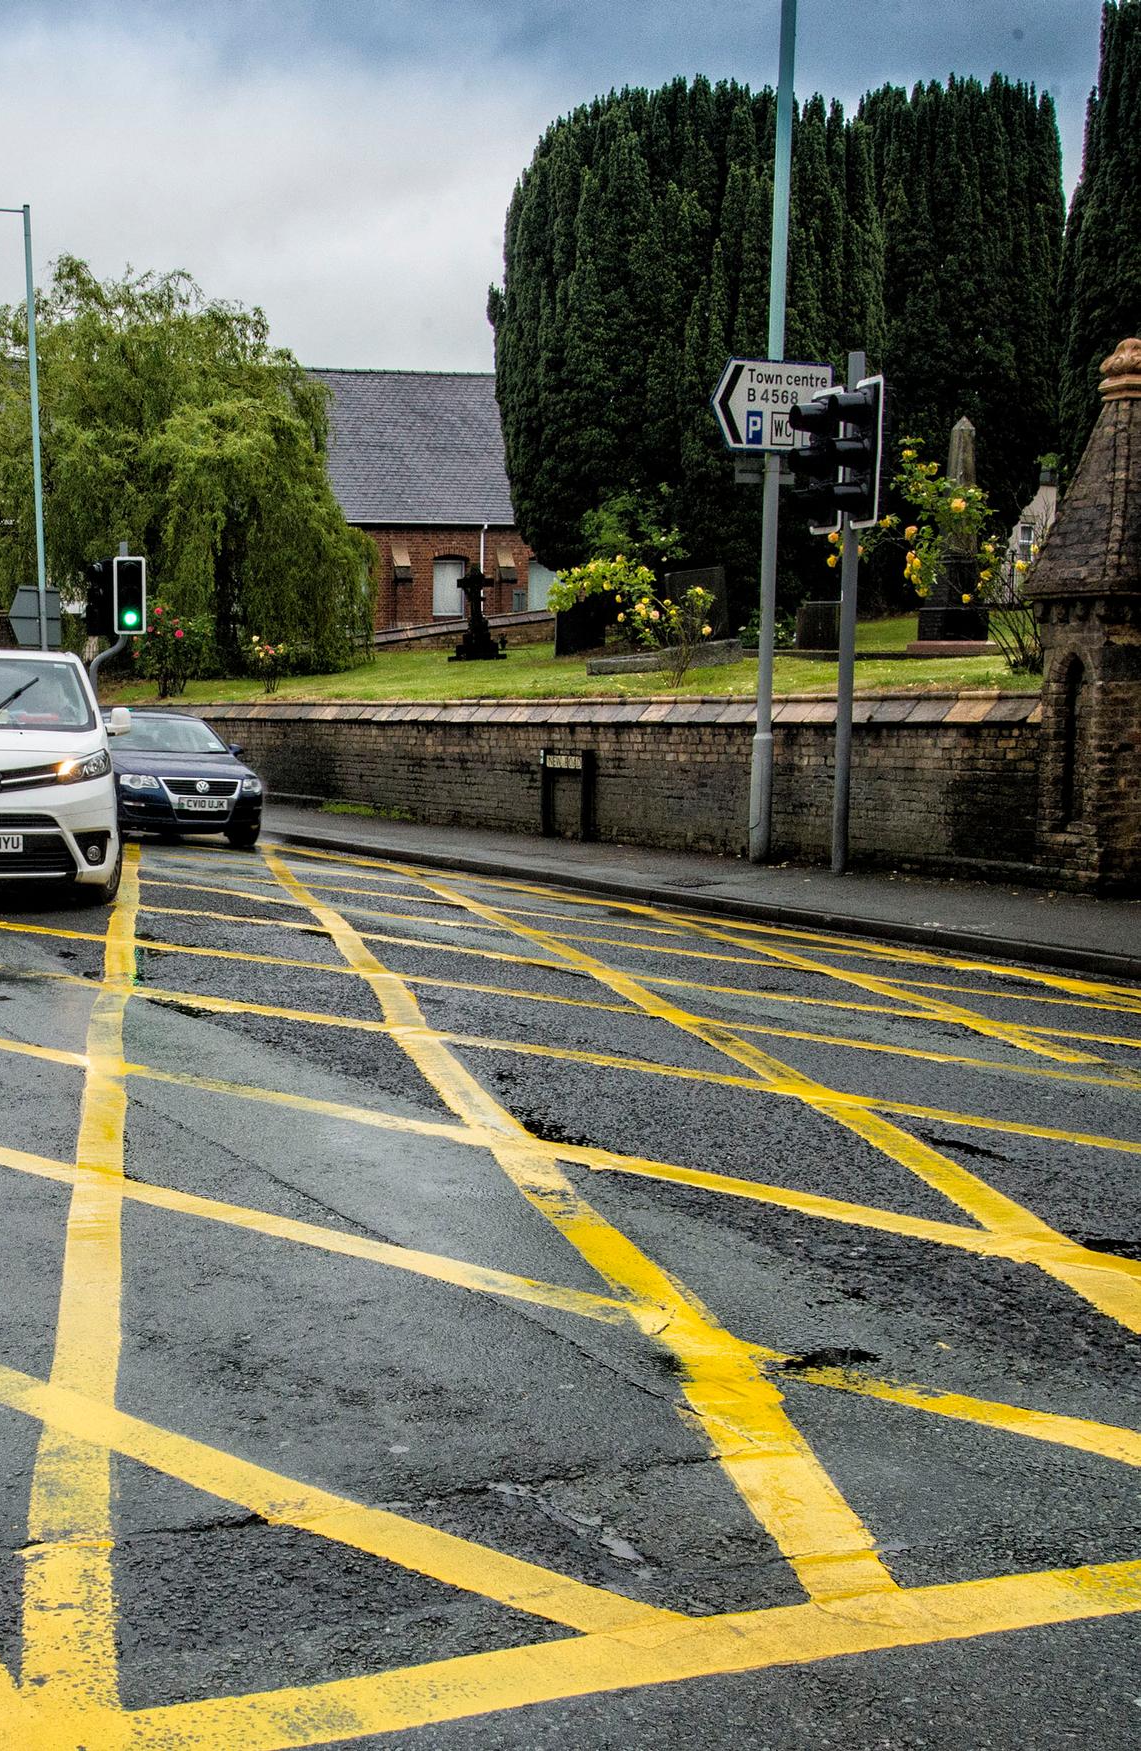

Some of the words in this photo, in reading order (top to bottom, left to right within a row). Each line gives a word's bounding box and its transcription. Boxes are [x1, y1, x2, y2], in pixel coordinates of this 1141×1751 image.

[748, 368, 783, 386] Town
[786, 372, 828, 388] centre
[747, 388, 756, 402] B
[760, 389, 798, 405] 4568
[748, 416, 761, 439] P
[774, 419, 792, 438] WC
[187, 799, 206, 808] CV10
[208, 800, 225, 808] UJK
